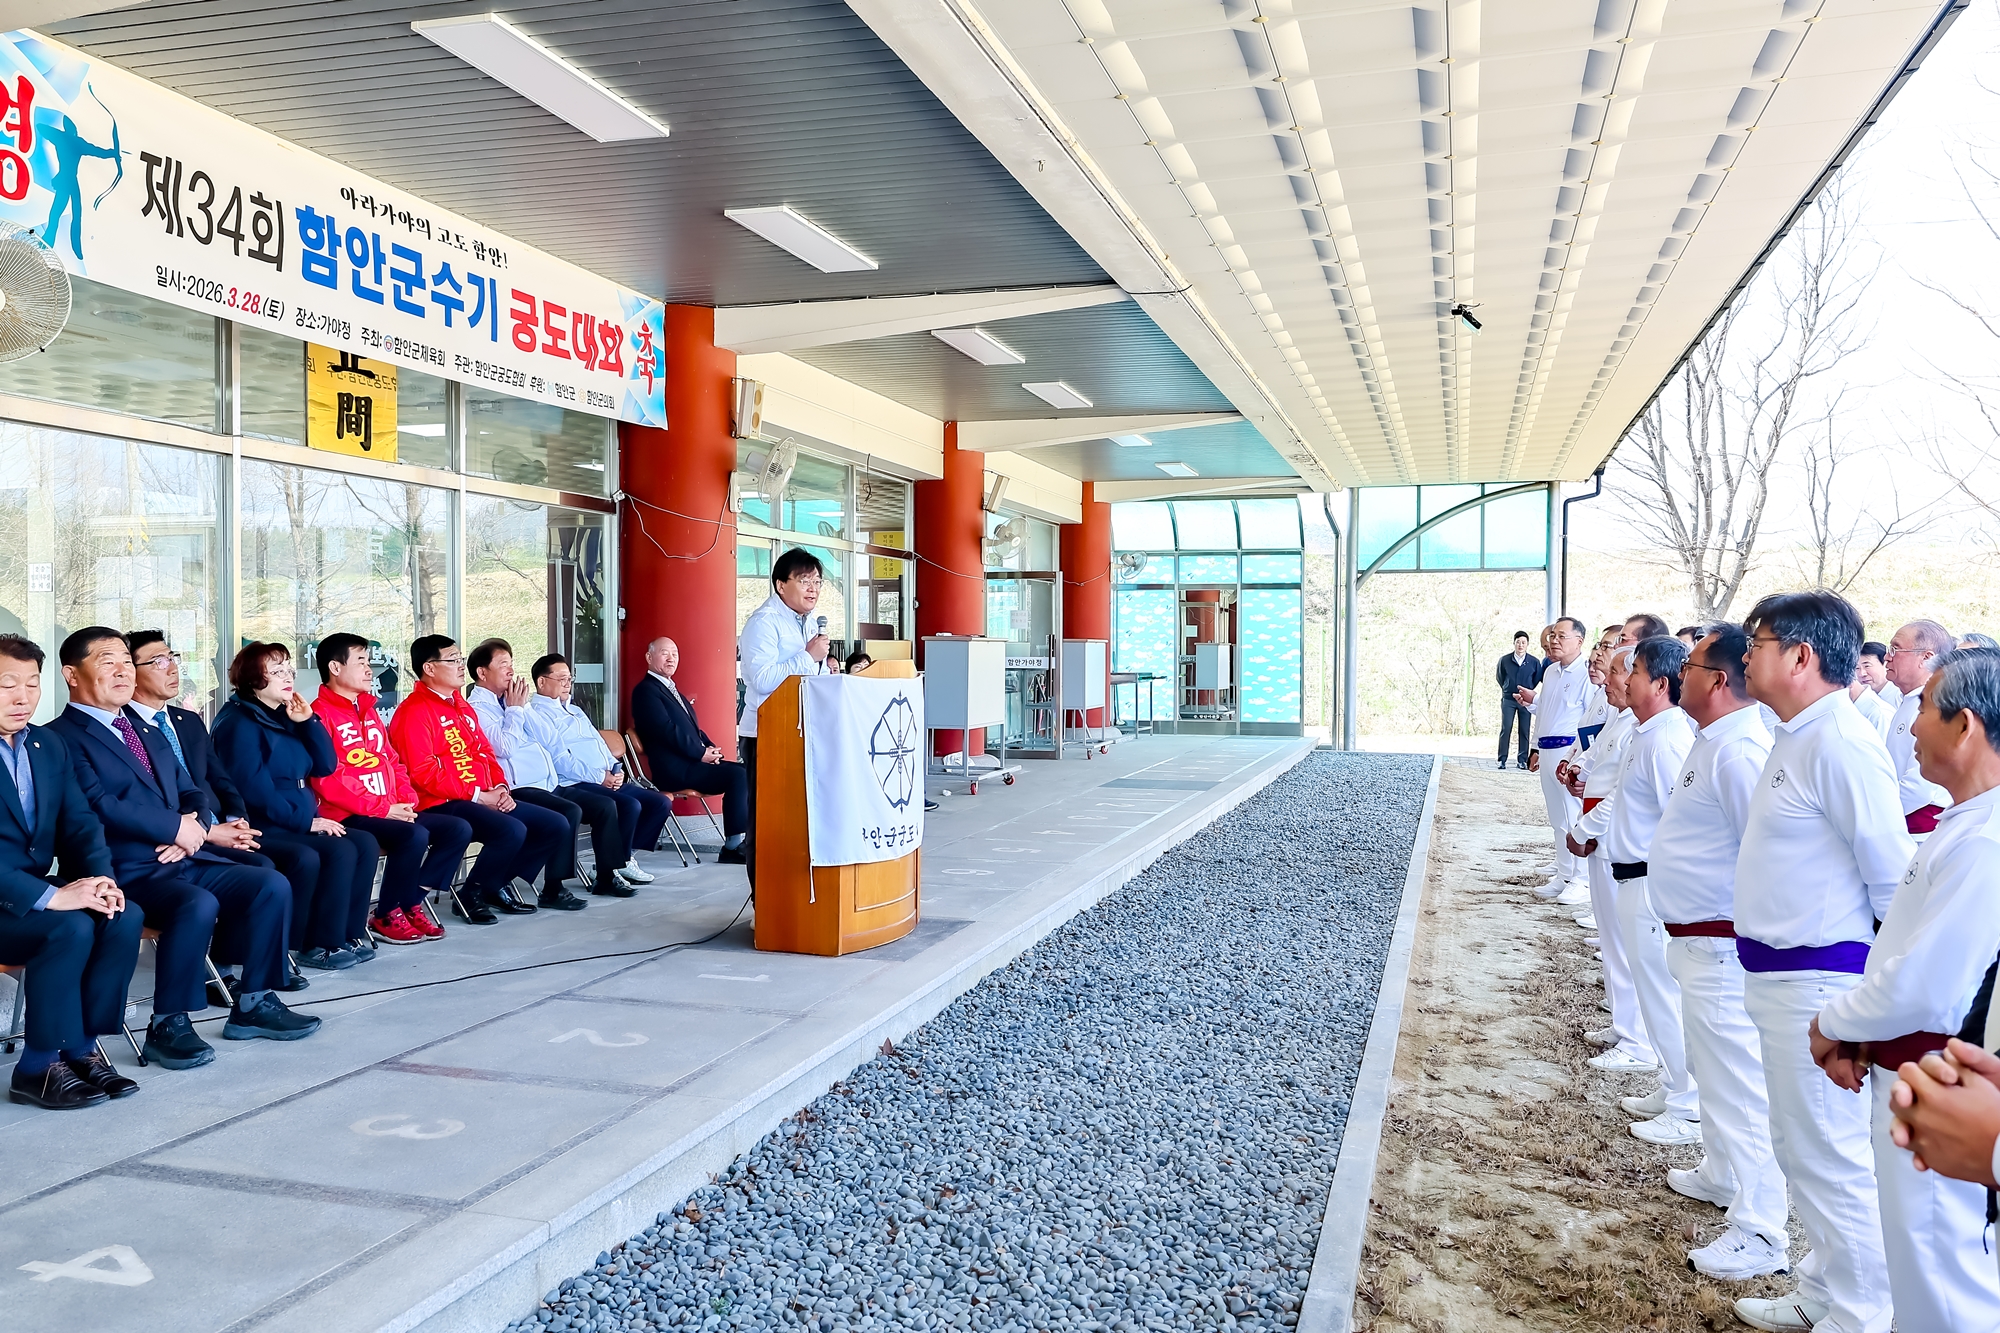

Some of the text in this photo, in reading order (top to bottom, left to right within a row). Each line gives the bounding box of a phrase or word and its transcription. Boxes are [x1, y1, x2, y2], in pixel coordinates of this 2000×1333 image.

[340, 187, 508, 269] 아라가야의 고도 함안!
[140, 151, 624, 378] 제34회 함안군수기 궁도대회
[394, 337, 446, 367] 함안군체육회
[555, 382, 576, 401] 함안군
[637, 319, 656, 396] 축
[547, 1027, 650, 1047] 2
[350, 1114, 466, 1140] 3
[16, 1244, 155, 1287] 4
